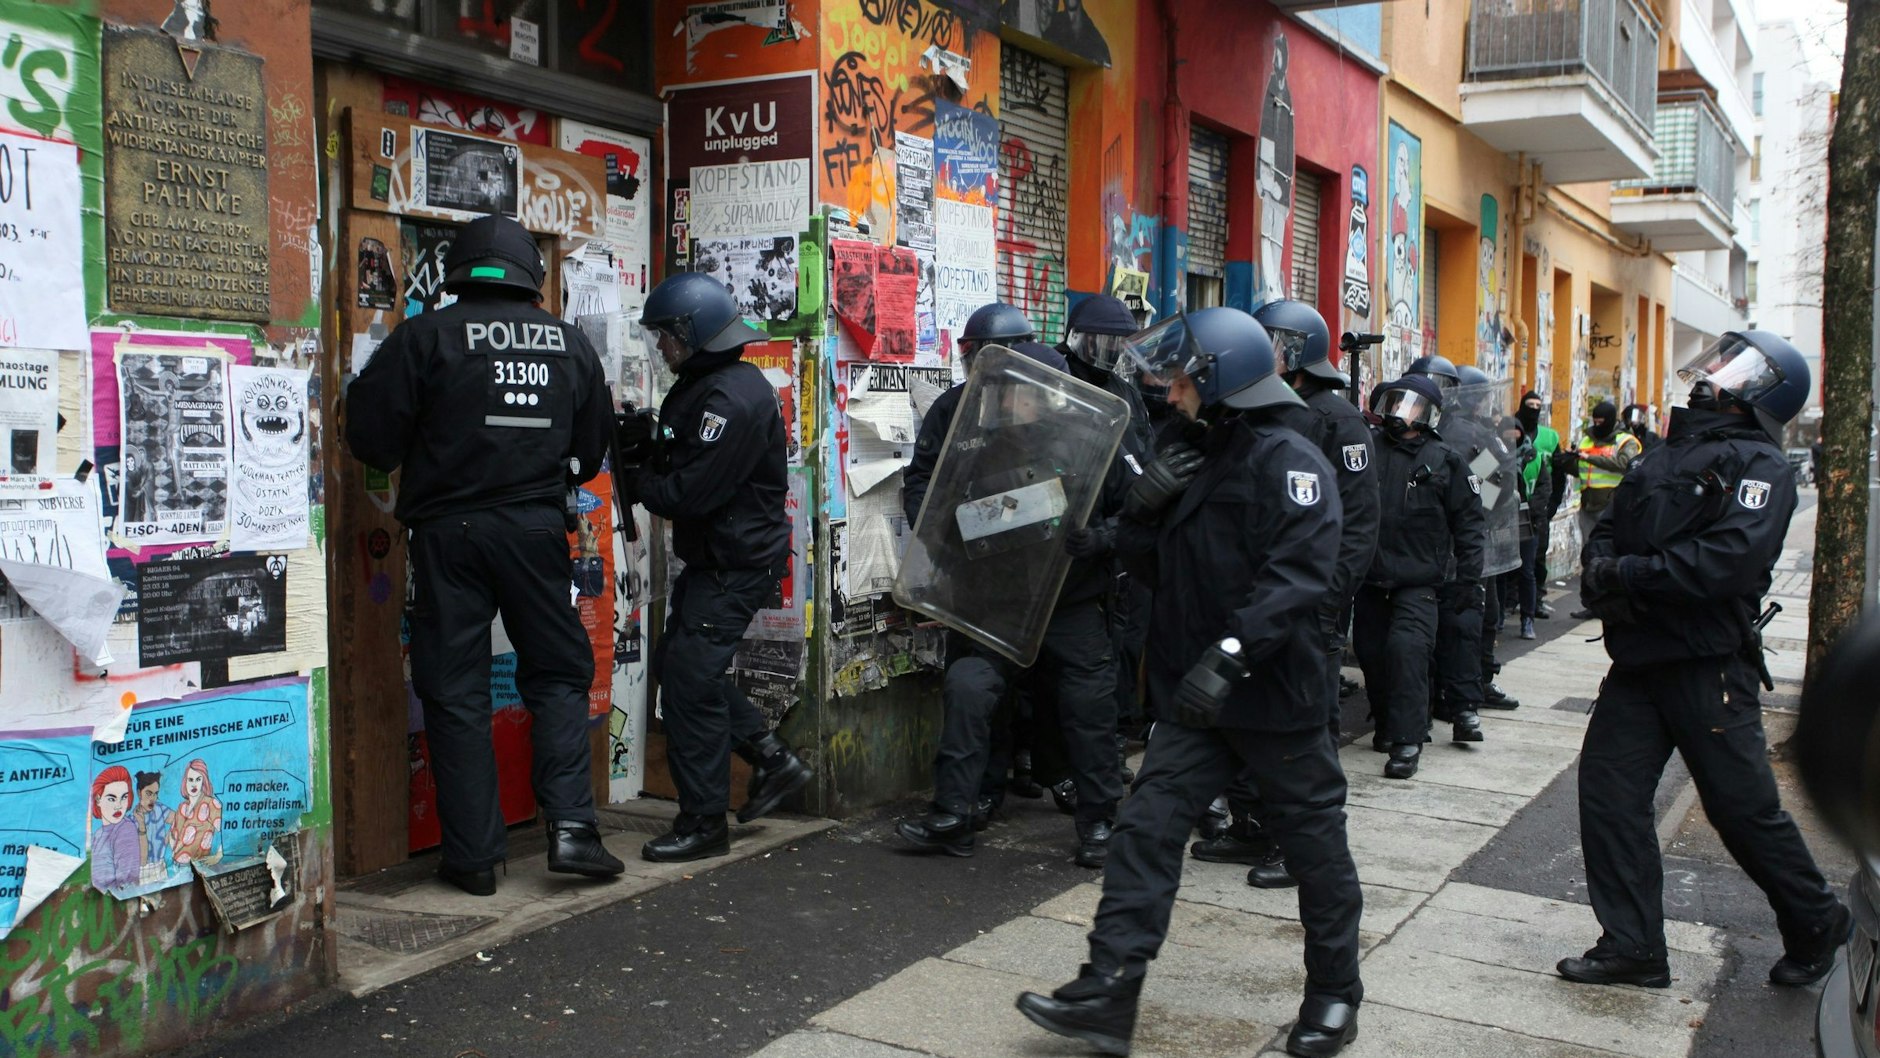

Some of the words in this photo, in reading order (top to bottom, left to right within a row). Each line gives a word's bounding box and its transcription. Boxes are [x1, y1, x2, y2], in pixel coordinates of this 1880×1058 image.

[122, 71, 138, 88] IN
[144, 75, 202, 99] DIESEM
[203, 87, 252, 112] HAUSE
[138, 95, 207, 121] WOHNTE
[211, 109, 238, 129] DER
[705, 100, 777, 138] KvU
[107, 110, 264, 150] ANTIFASCHISTISCHE
[704, 131, 778, 153] unplugged
[107, 128, 266, 170] WIDERSTANDSKÄMPFER
[156, 158, 230, 189] ERNST
[694, 160, 801, 195] KOPFSTAND
[143, 181, 243, 216] PAHNKE
[723, 197, 800, 227] SUPAMOLLY
[165, 214, 190, 232] AM
[112, 227, 147, 247] VON
[151, 231, 181, 250] DEN
[185, 235, 268, 259] FASCHISTEN
[112, 247, 188, 270] ERMORDET
[189, 255, 213, 272] AM
[114, 267, 132, 282] IN
[136, 269, 270, 296] BERLIN-PLÖTZENSEE
[937, 265, 990, 293] KOPFSTAND
[114, 286, 150, 304] EHRE
[150, 289, 201, 309] SEINEM
[201, 294, 271, 314] ANDENKEN
[465, 322, 567, 352] POLIZEI
[494, 360, 550, 387] 31300
[776, 356, 789, 369] IST
[37, 495, 86, 511] SUBVERSE
[96, 719, 244, 758] QUEER_FEMINISTISCHE
[246, 712, 290, 731] ANTIFA!
[126, 715, 151, 735] FÜR
[155, 714, 185, 731] EINE
[9, 766, 67, 783] ANTIFA!
[228, 780, 242, 793] no
[226, 800, 240, 812] no
[223, 818, 239, 830] no
[241, 816, 285, 830] fortress
